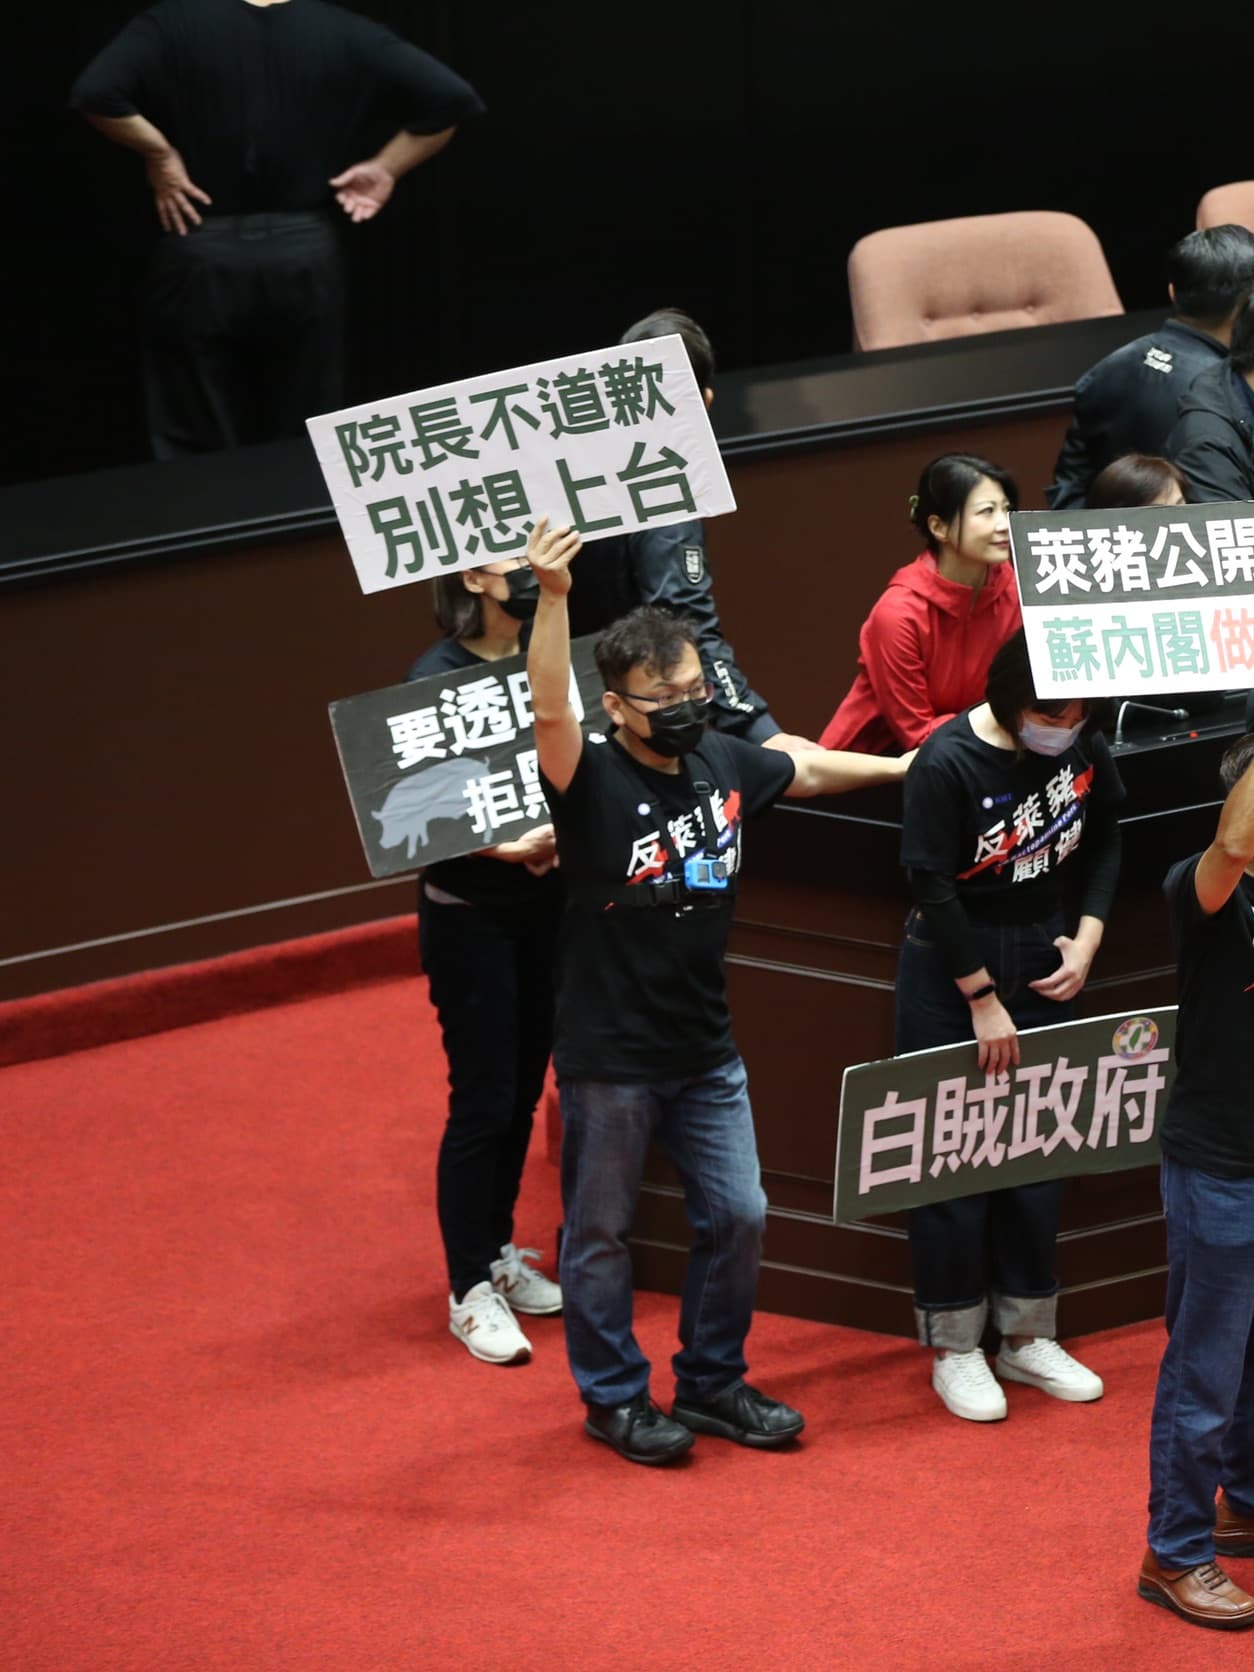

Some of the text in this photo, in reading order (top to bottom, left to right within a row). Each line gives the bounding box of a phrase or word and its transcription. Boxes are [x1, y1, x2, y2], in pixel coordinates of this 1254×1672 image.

[335, 356, 676, 489] 院長不道歉
[366, 441, 698, 579] 別想上台
[974, 764, 1078, 863] 反萊豬
[858, 1045, 1170, 1195] 白賊政府
